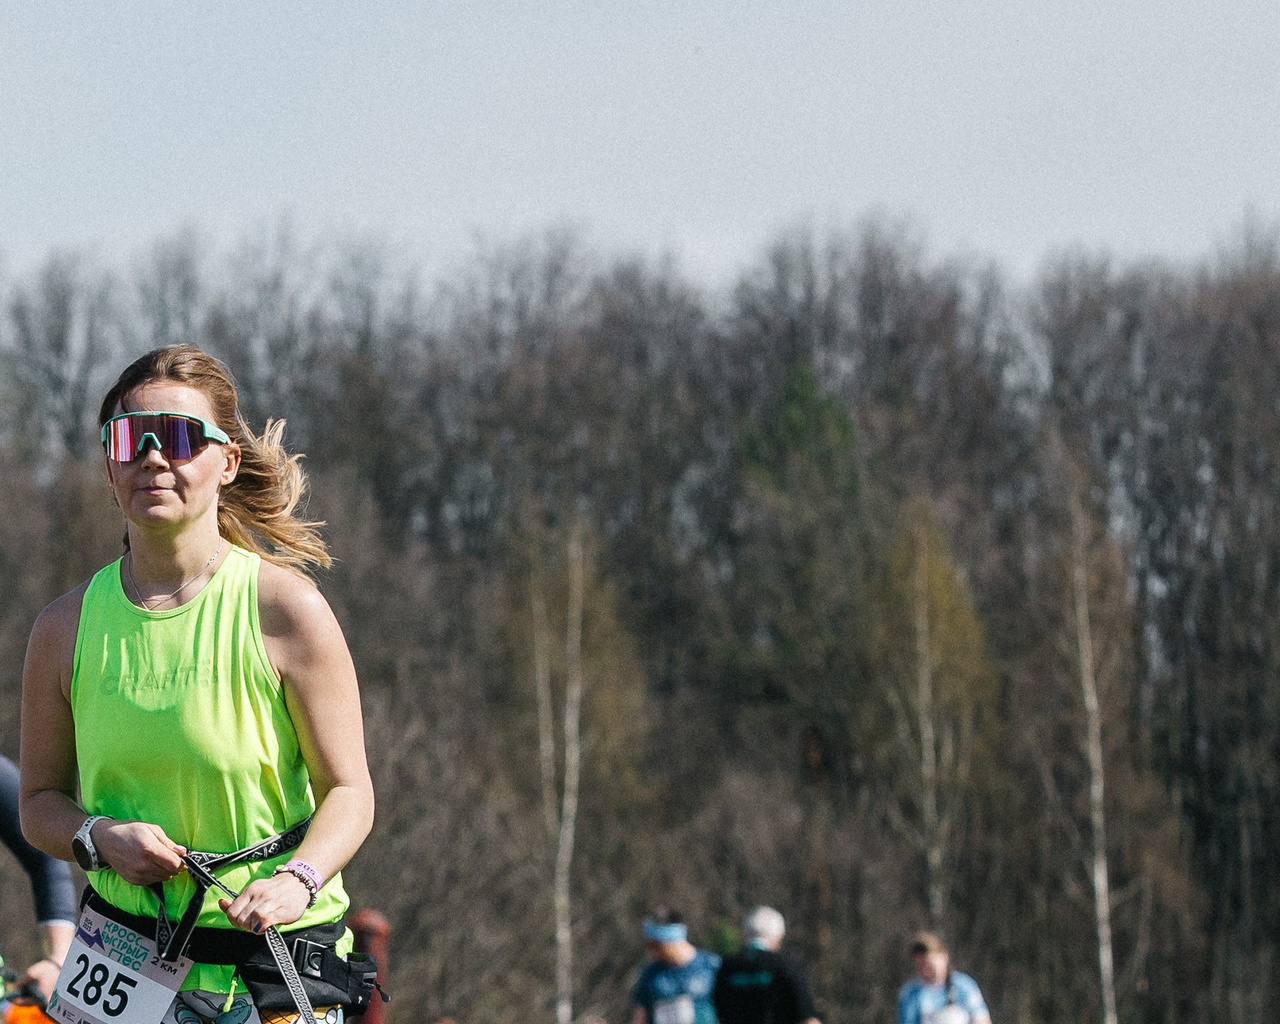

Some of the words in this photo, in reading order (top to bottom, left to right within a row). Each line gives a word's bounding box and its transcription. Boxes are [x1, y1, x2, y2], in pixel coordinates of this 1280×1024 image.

[103, 919, 143, 946] КРОСС
[150, 956, 160, 966] 2
[66, 953, 139, 1017] 285
